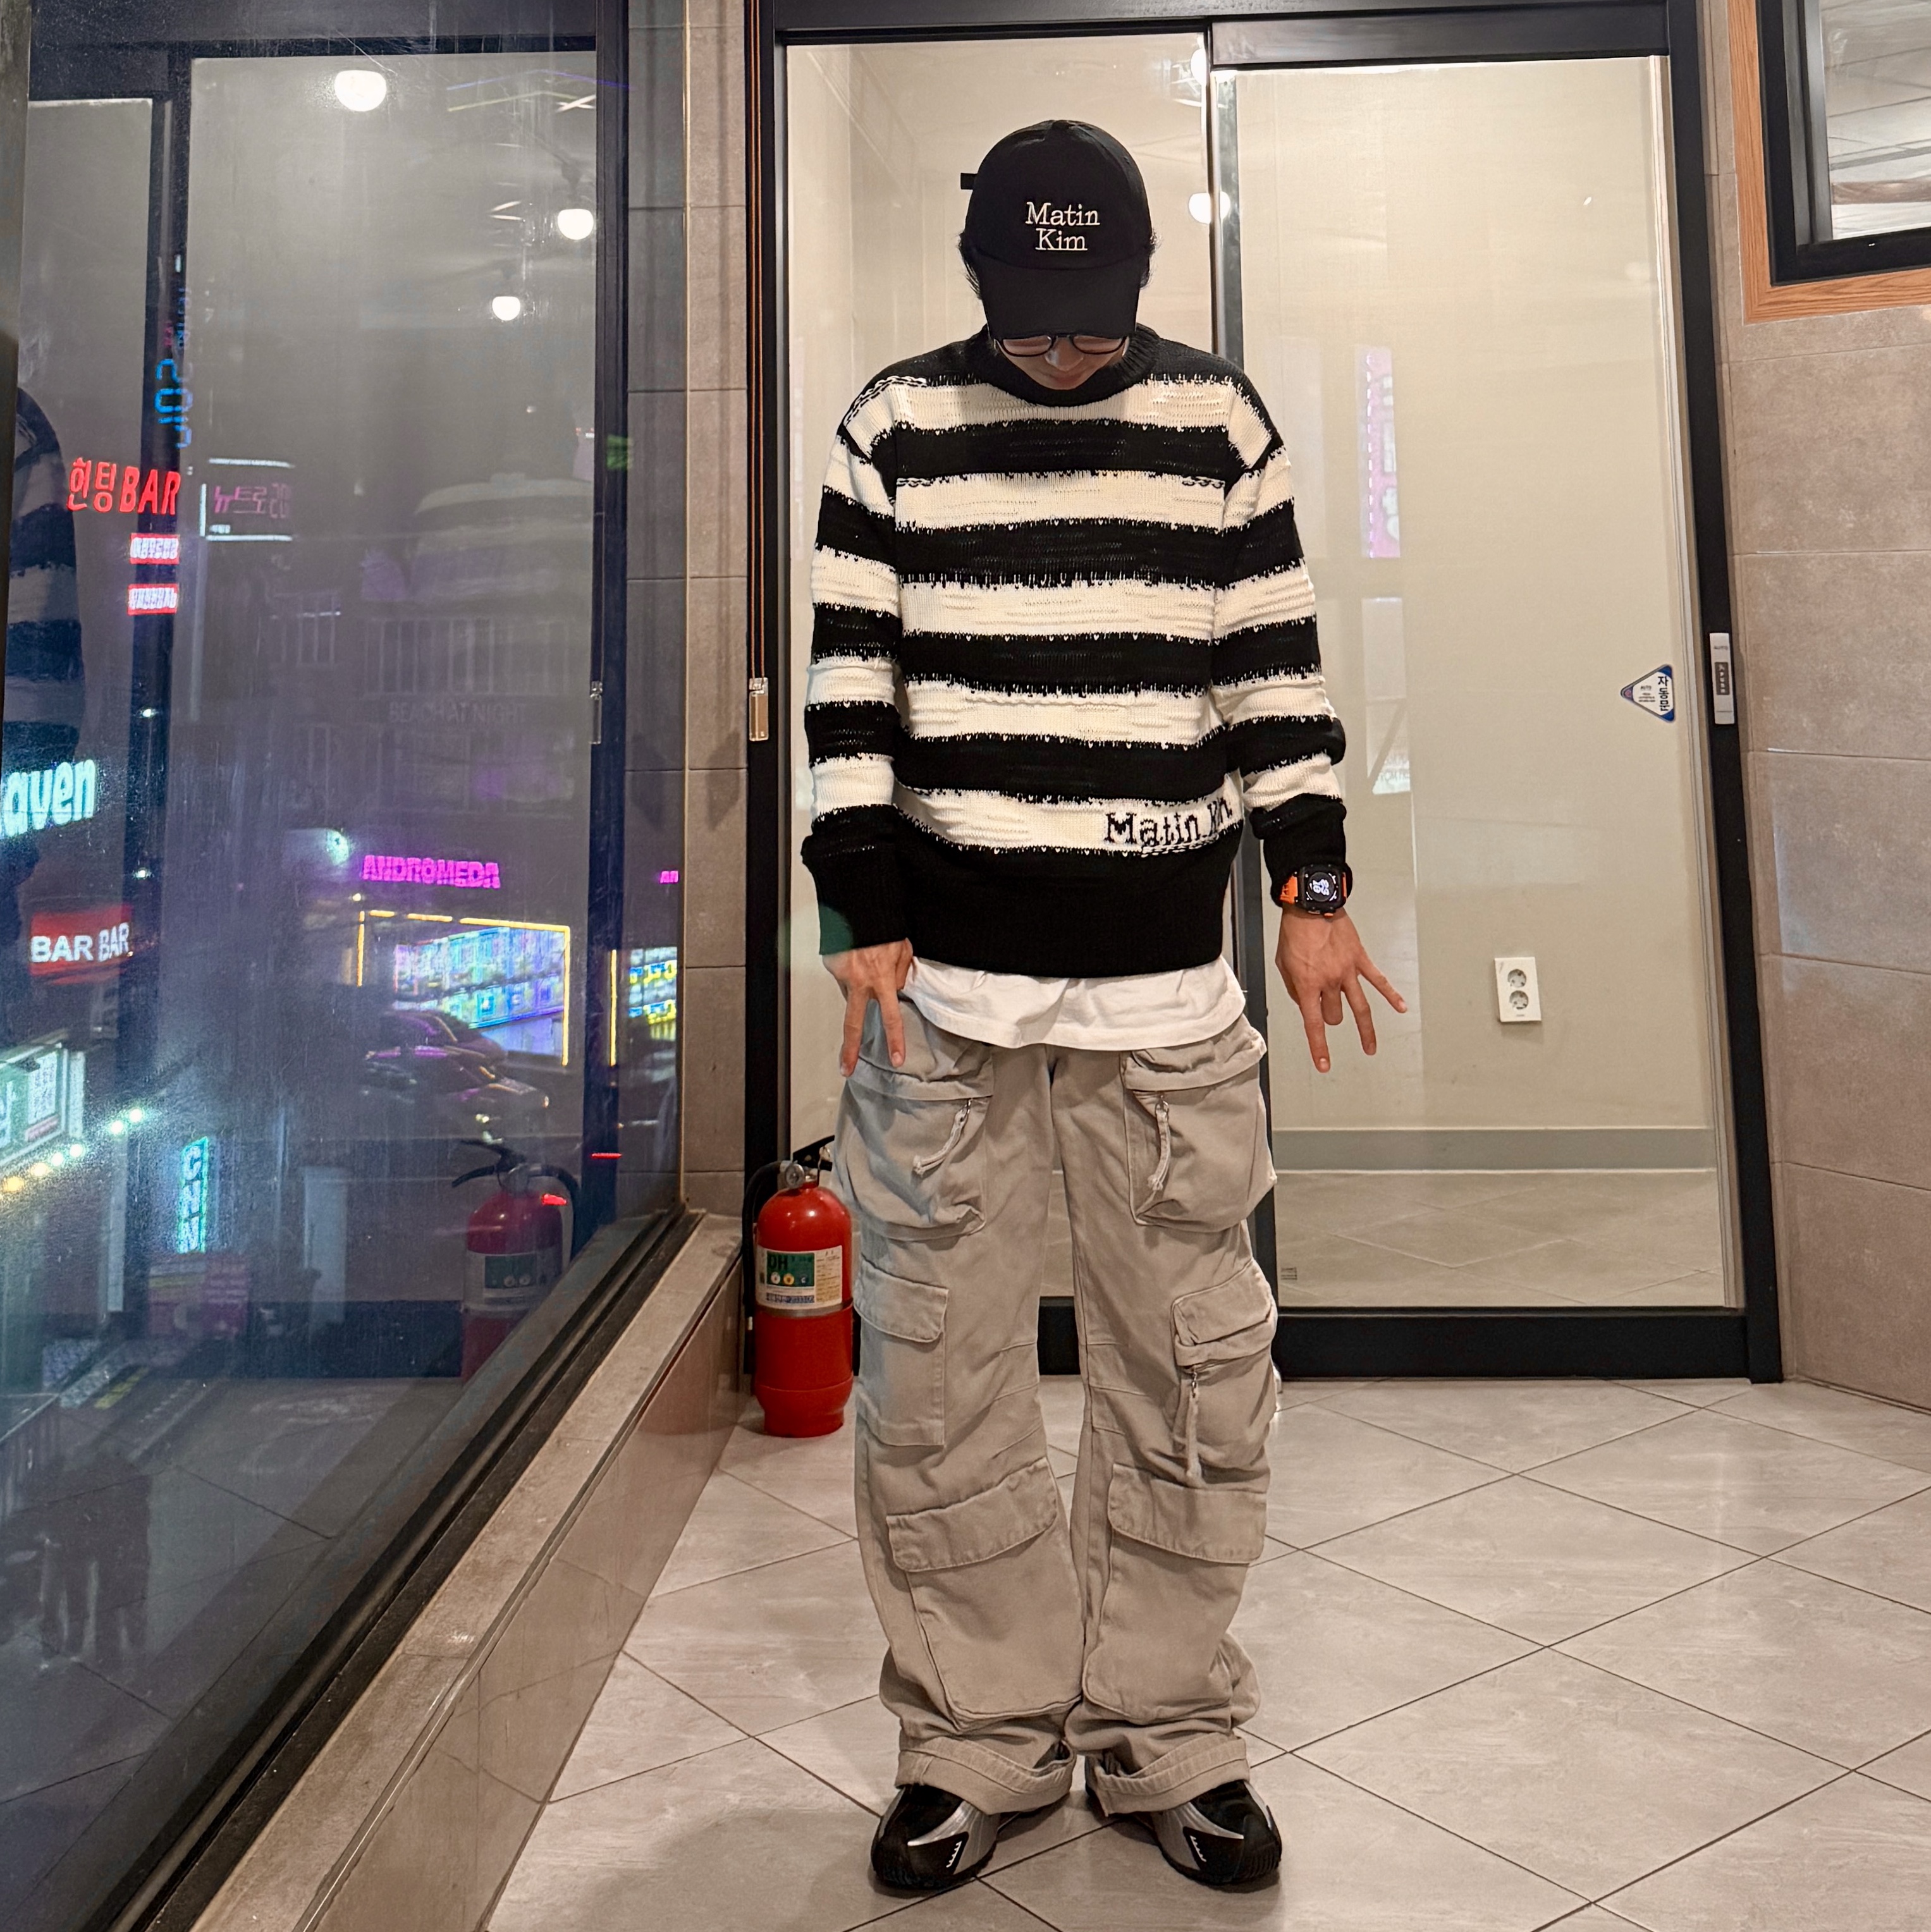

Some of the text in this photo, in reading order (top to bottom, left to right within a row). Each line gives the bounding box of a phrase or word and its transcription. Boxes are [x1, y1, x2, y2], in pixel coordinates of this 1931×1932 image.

[1025, 201, 1100, 226] Matin
[1035, 228, 1088, 251] Kim
[1657, 675, 1670, 711] 자동문
[1105, 812, 1201, 847] Matin
[362, 855, 501, 888] ANDROMEDA
[31, 935, 94, 963] BAR
[99, 922, 130, 962] BAR
